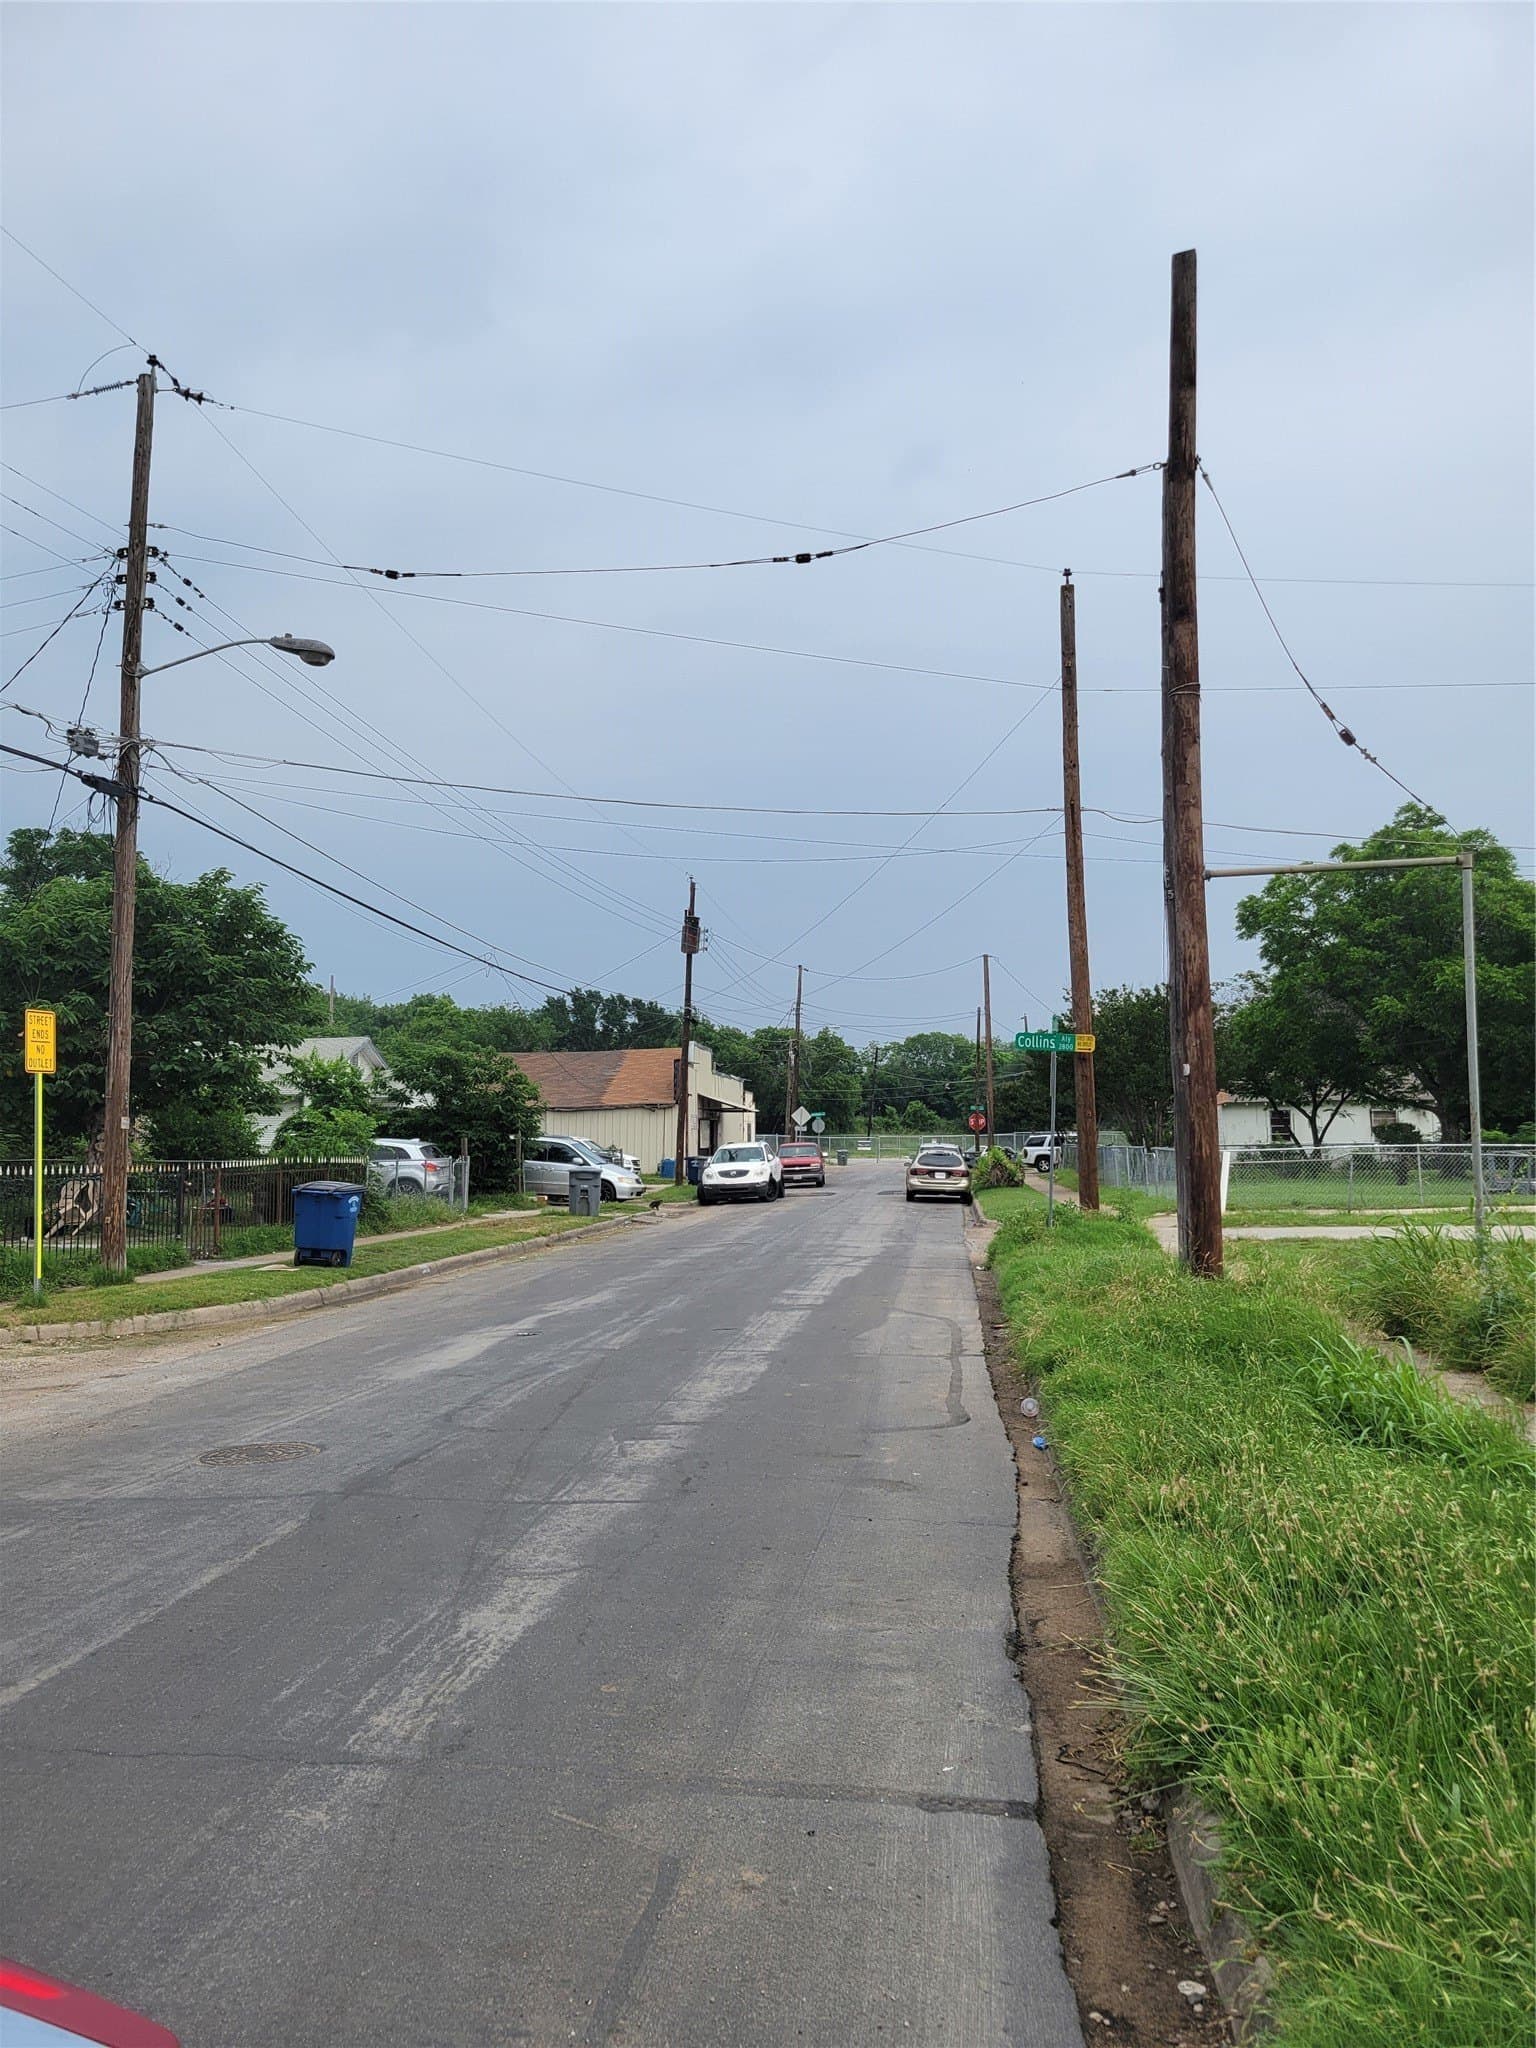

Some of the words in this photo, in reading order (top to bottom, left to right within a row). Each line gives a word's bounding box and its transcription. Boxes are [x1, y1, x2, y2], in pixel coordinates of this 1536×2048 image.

[29, 1015, 52, 1026] STREET
[32, 1028, 49, 1039] ENDS
[1018, 1035, 1055, 1049] Collins
[1061, 1035, 1071, 1043] Aly
[36, 1045, 45, 1055] NO
[29, 1058, 52, 1069] OUTLET
